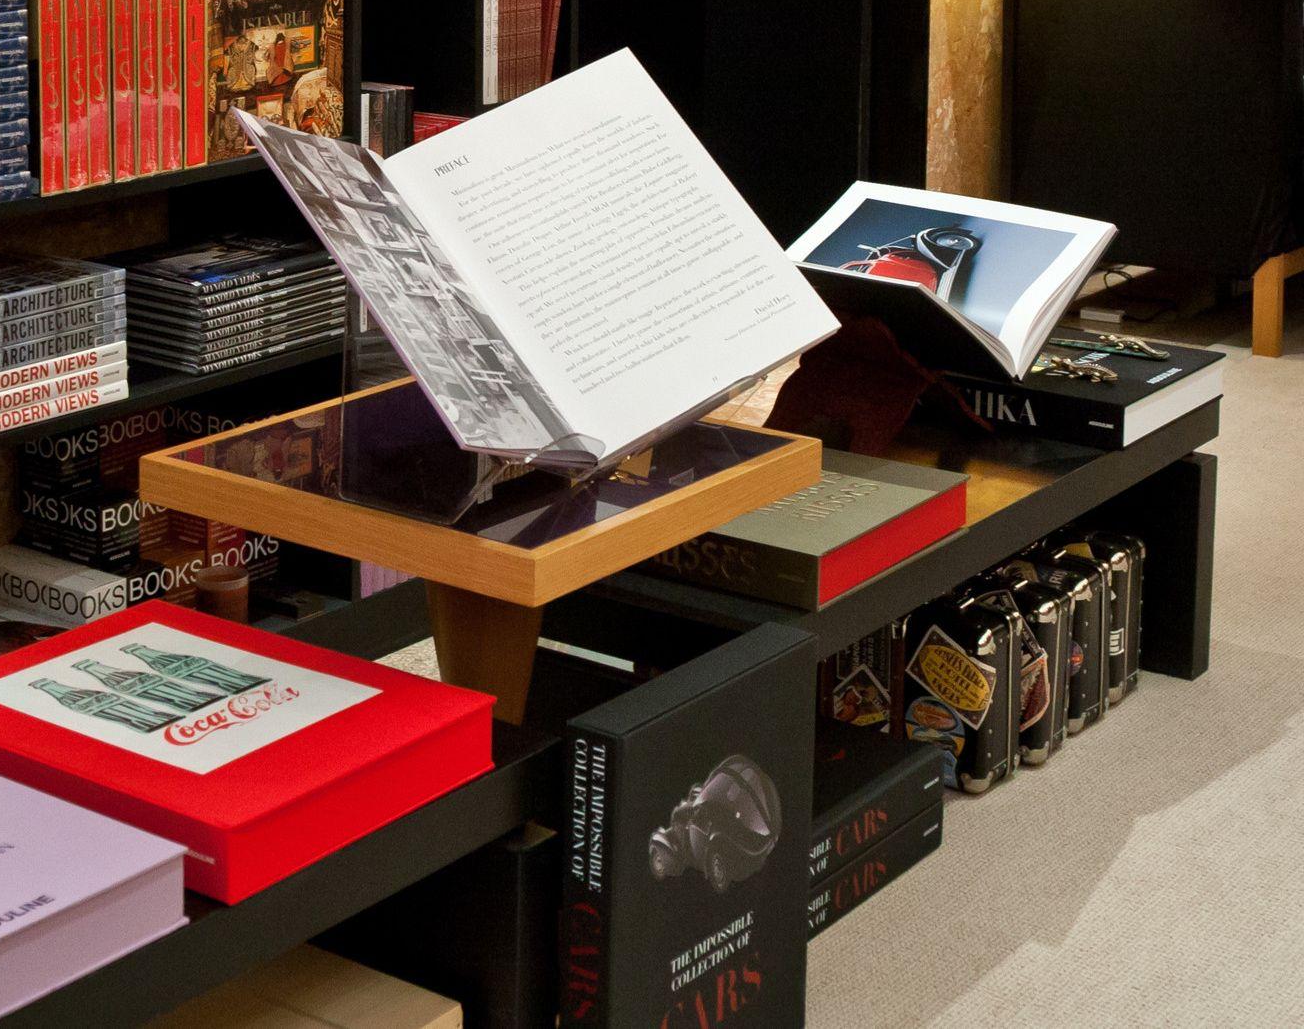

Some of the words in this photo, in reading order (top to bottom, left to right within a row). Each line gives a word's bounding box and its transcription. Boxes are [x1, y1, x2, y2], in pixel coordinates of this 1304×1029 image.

[2, 281, 95, 317] ARCHITECTURE
[54, 352, 98, 377] VIEWS
[48, 585, 127, 620] BOOKS
[129, 558, 203, 603] BOOKS
[835, 808, 888, 856] CARS
[670, 950, 693, 974] THE
[693, 911, 755, 960] IMPOSSIBLE
[670, 941, 735, 992] COLLECTION
[736, 930, 752, 950] OF
